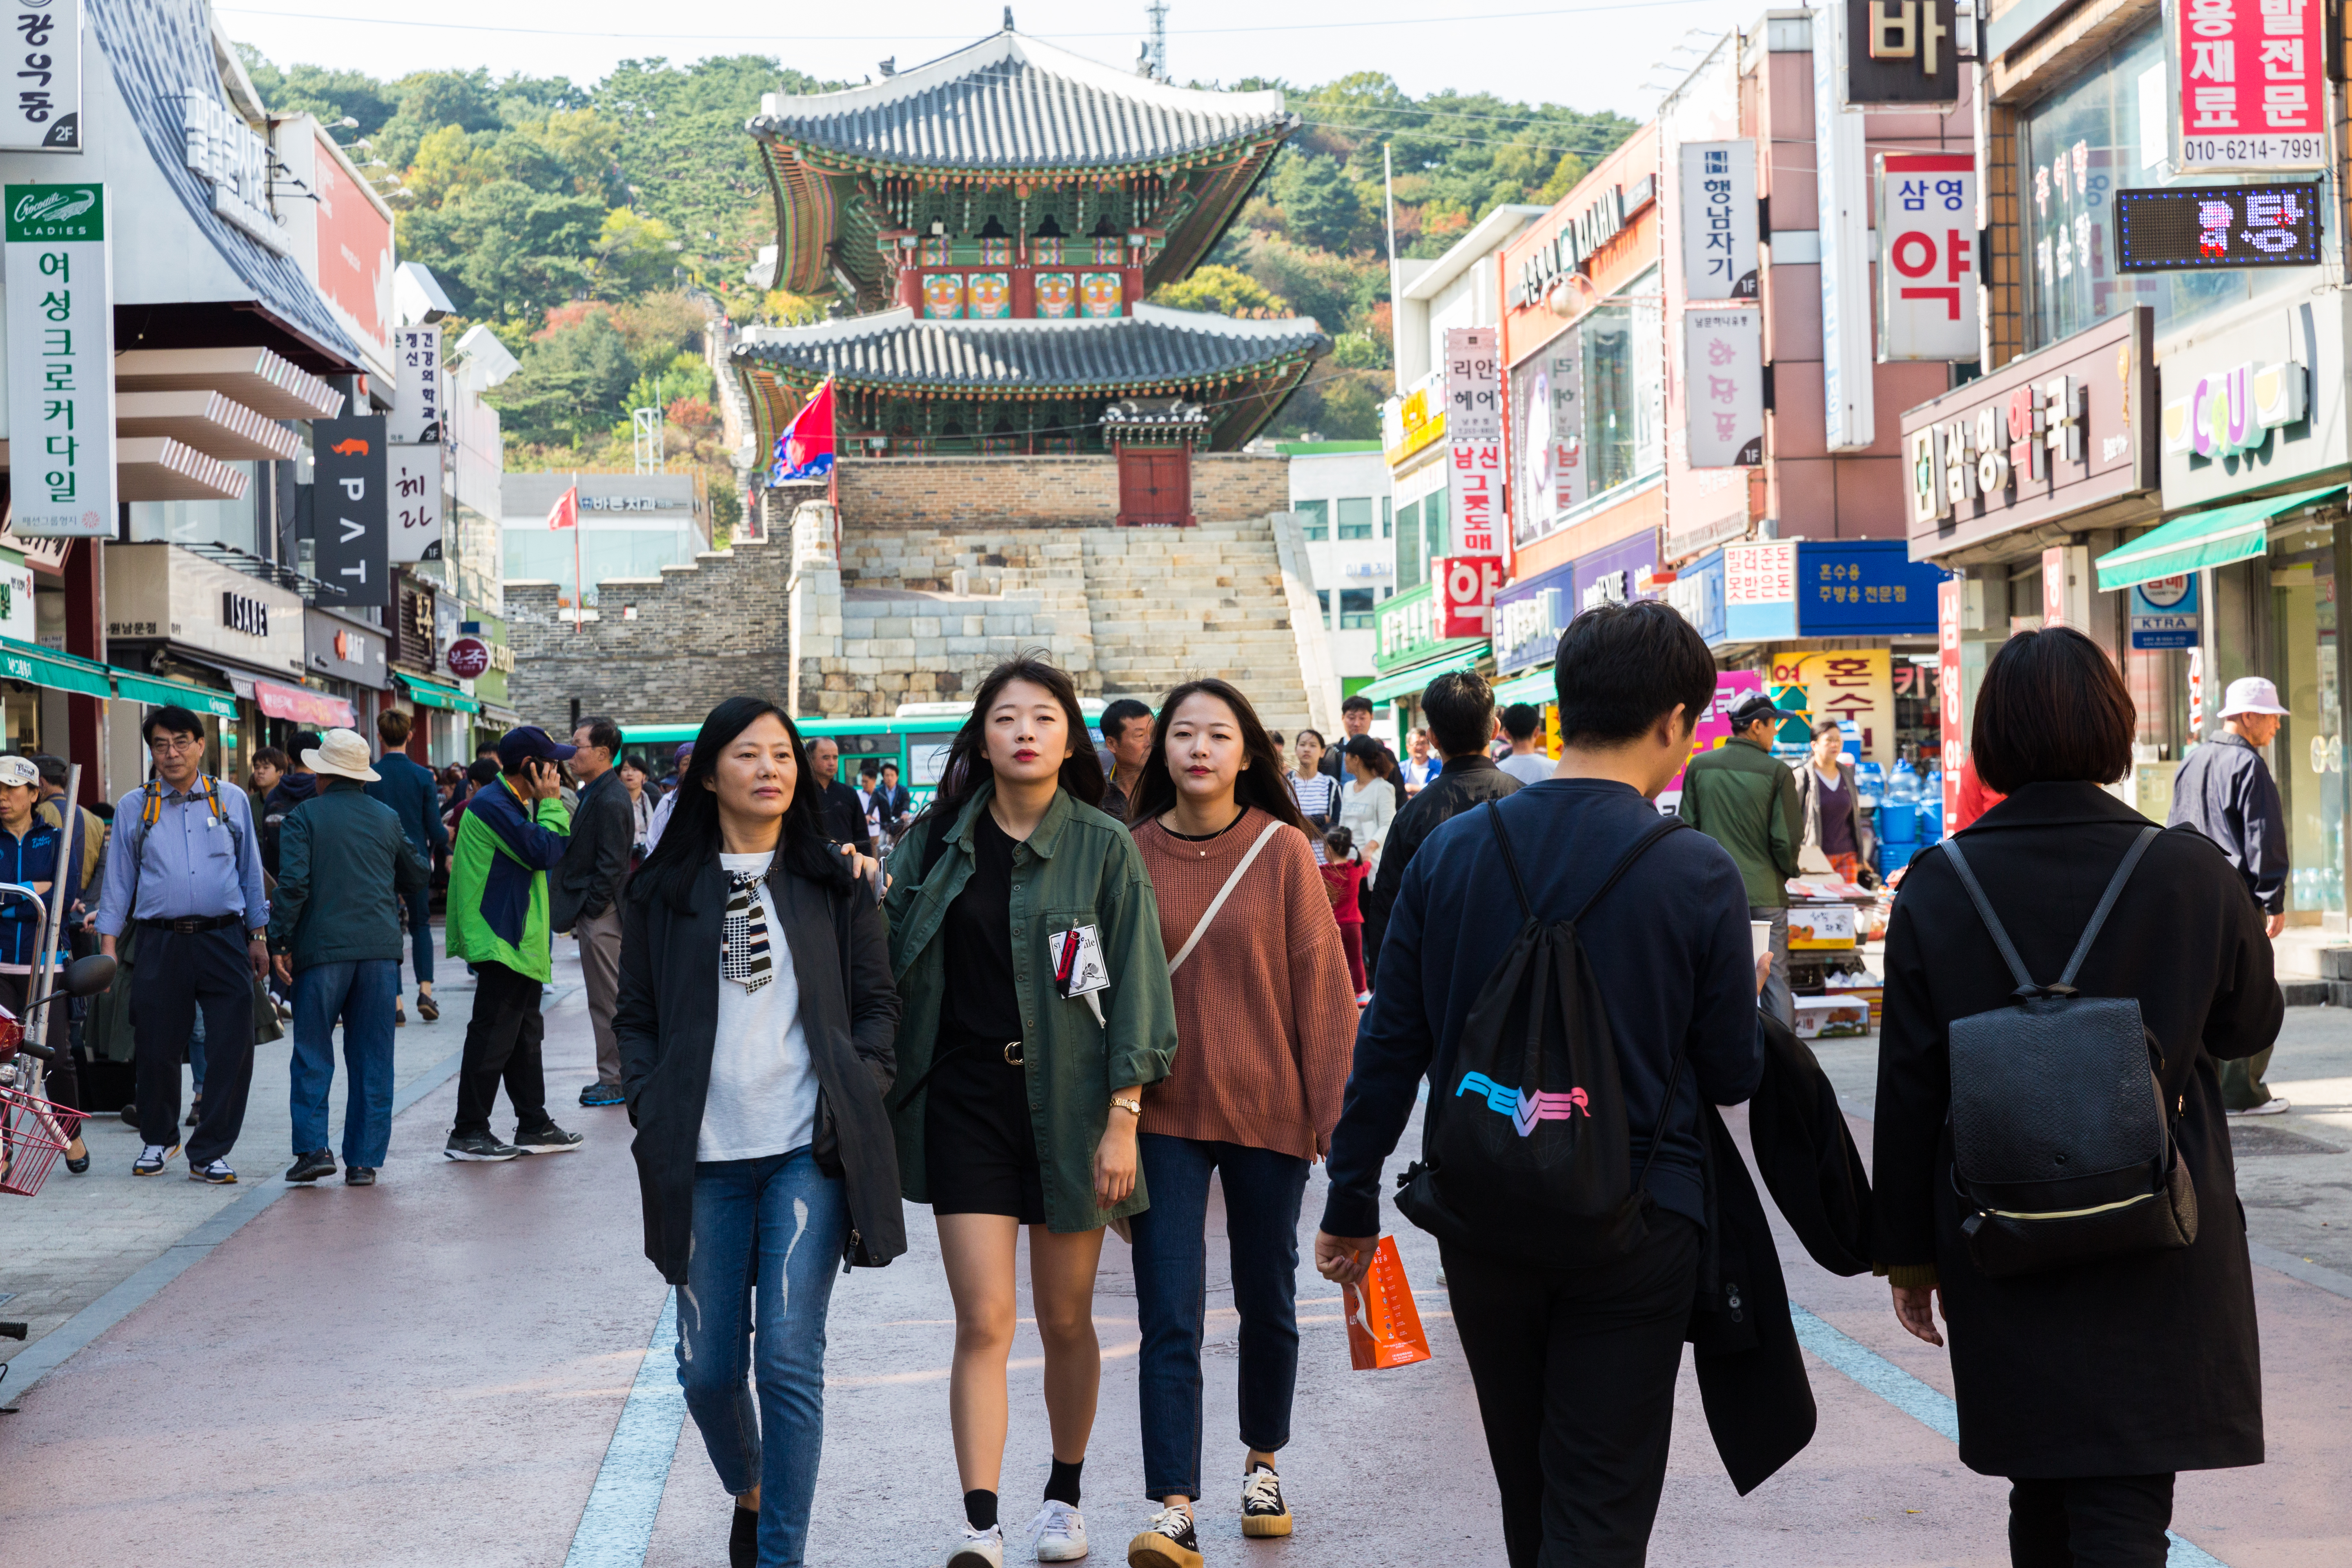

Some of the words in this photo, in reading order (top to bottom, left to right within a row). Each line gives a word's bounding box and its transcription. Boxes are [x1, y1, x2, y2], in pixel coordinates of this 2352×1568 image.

[56, 126, 73, 141] 2F
[2186, 139, 2321, 160] 010-6214-7991
[1899, 180, 1963, 211] 삼영
[24, 226, 86, 236] LADIES
[1704, 179, 1735, 281] 행남자기
[1891, 229, 1971, 321] 약
[1741, 279, 1755, 293] 1F
[1454, 359, 1494, 380] 리안
[1454, 391, 1494, 411] 헤어
[426, 430, 437, 441] 2F
[1946, 374, 2069, 504] 삼영약국
[1745, 450, 1759, 463] 1F
[339, 477, 366, 583] PAT
[428, 548, 439, 558] 1F
[1448, 563, 1499, 634] 약
[224, 592, 269, 636] ISABEY
[2143, 617, 2187, 628] KTRA
[106, 622, 156, 635] 원남문점
[1456, 1071, 1591, 1137] FEVER
